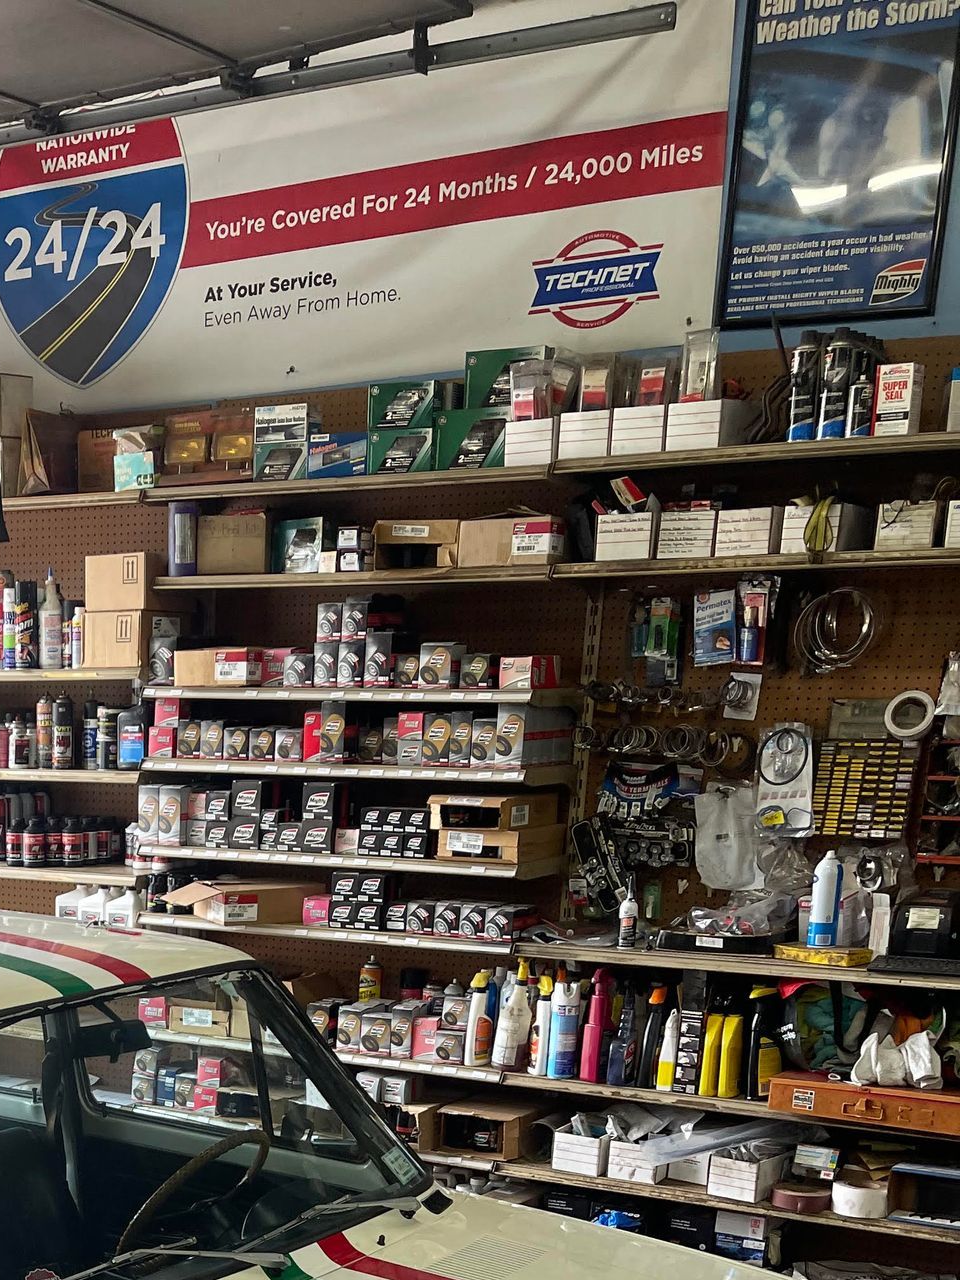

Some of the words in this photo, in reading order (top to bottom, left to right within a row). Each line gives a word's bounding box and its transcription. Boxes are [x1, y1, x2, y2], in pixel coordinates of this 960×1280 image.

[757, 14, 841, 45] Weather
[846, 7, 880, 32] the
[41, 142, 130, 174] WARRANTY
[205, 214, 266, 242] You're
[272, 198, 356, 230] Covered
[363, 189, 399, 214] For
[403, 184, 431, 208] 24
[439, 171, 519, 203] Months
[524, 165, 537, 189] /
[544, 152, 633, 187] 24,000
[641, 142, 704, 171] Miles
[4, 202, 166, 282] 24/24
[575, 232, 621, 246] AUTOMOTIVE
[733, 246, 750, 255] Over
[783, 240, 819, 251] accidents
[827, 239, 844, 248] year
[846, 236, 867, 245] occur
[879, 233, 893, 242] bad
[732, 255, 753, 265] Avoid
[754, 254, 779, 264] having
[791, 250, 823, 260] accident
[825, 249, 839, 257] due
[841, 248, 849, 256] to
[851, 247, 868, 256] poor
[870, 243, 905, 253] visibility.
[731, 271, 741, 281] Let
[743, 271, 753, 279] us
[754, 268, 781, 279] change
[782, 268, 799, 277] your
[800, 265, 821, 274] wiper
[823, 263, 851, 273] blades.
[205, 286, 224, 304] At
[228, 281, 267, 302] Your
[271, 270, 338, 294] Service,
[581, 282, 635, 294] PROFESSIONAL
[875, 275, 921, 292] Mighty
[204, 309, 242, 328] Even
[247, 302, 290, 325] Away
[297, 295, 340, 315] From
[346, 287, 402, 308] Home.
[576, 319, 607, 328] SERVICE
[882, 380, 908, 392] SUPER
[885, 390, 903, 401] SEAL
[310, 442, 338, 455] Halogen
[696, 599, 732, 614] Permatex
